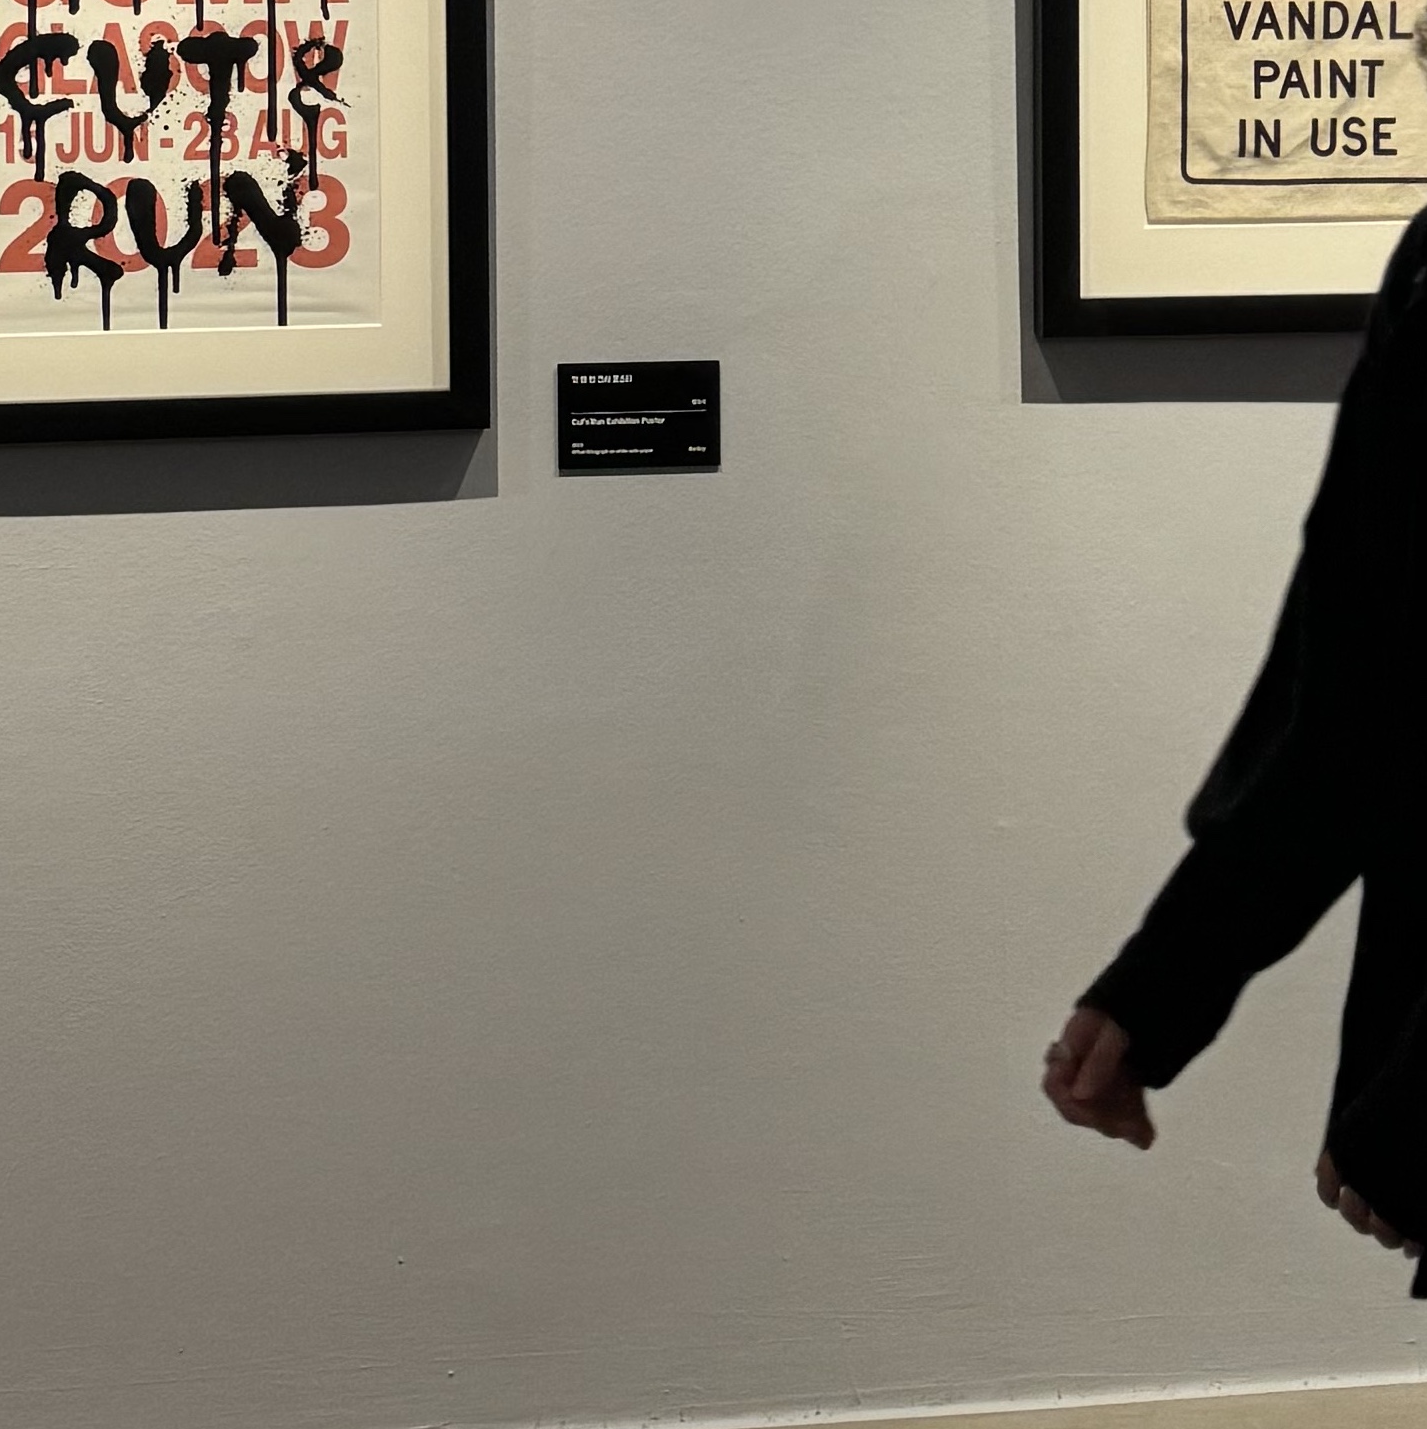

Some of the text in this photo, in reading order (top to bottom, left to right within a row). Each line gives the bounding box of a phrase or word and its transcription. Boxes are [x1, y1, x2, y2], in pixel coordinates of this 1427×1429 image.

[1223, 0, 1414, 40] VANDAL
[1253, 59, 1385, 99] PAINT
[55, 111, 149, 163] JUN
[248, 107, 347, 160] AUG
[1238, 117, 1398, 157] IN USE
[44, 170, 304, 288] RUN
